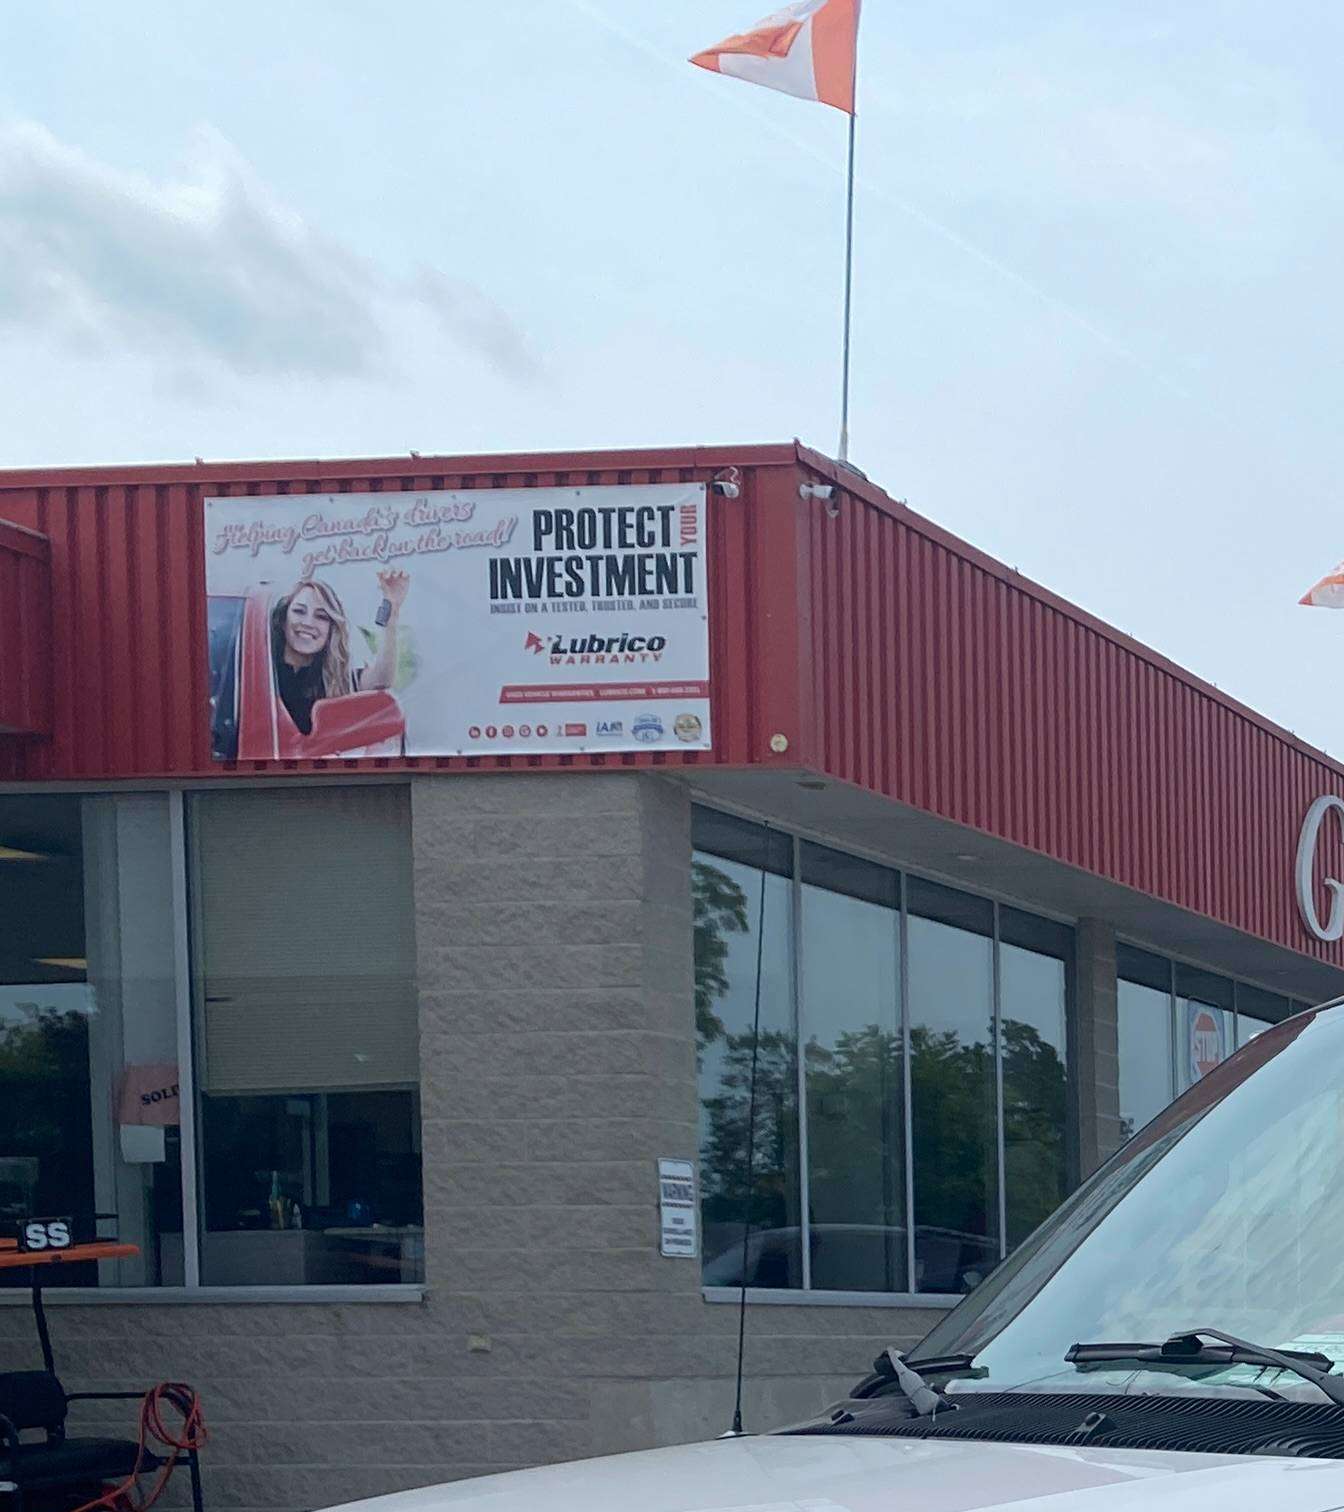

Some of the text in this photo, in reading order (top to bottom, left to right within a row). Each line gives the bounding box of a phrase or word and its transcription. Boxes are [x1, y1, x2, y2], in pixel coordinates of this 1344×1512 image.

[212, 498, 476, 557] Helping Canada's drivers
[533, 505, 675, 551] PROTECT
[680, 504, 697, 546] YOUR
[301, 545, 334, 581] get
[338, 531, 389, 563] back
[417, 526, 450, 553] the
[452, 516, 517, 546] road!
[489, 552, 698, 599] INVESTMENT
[550, 632, 667, 654] Lubrico
[550, 653, 663, 665] WARRANTY
[26, 1222, 70, 1249] SS
